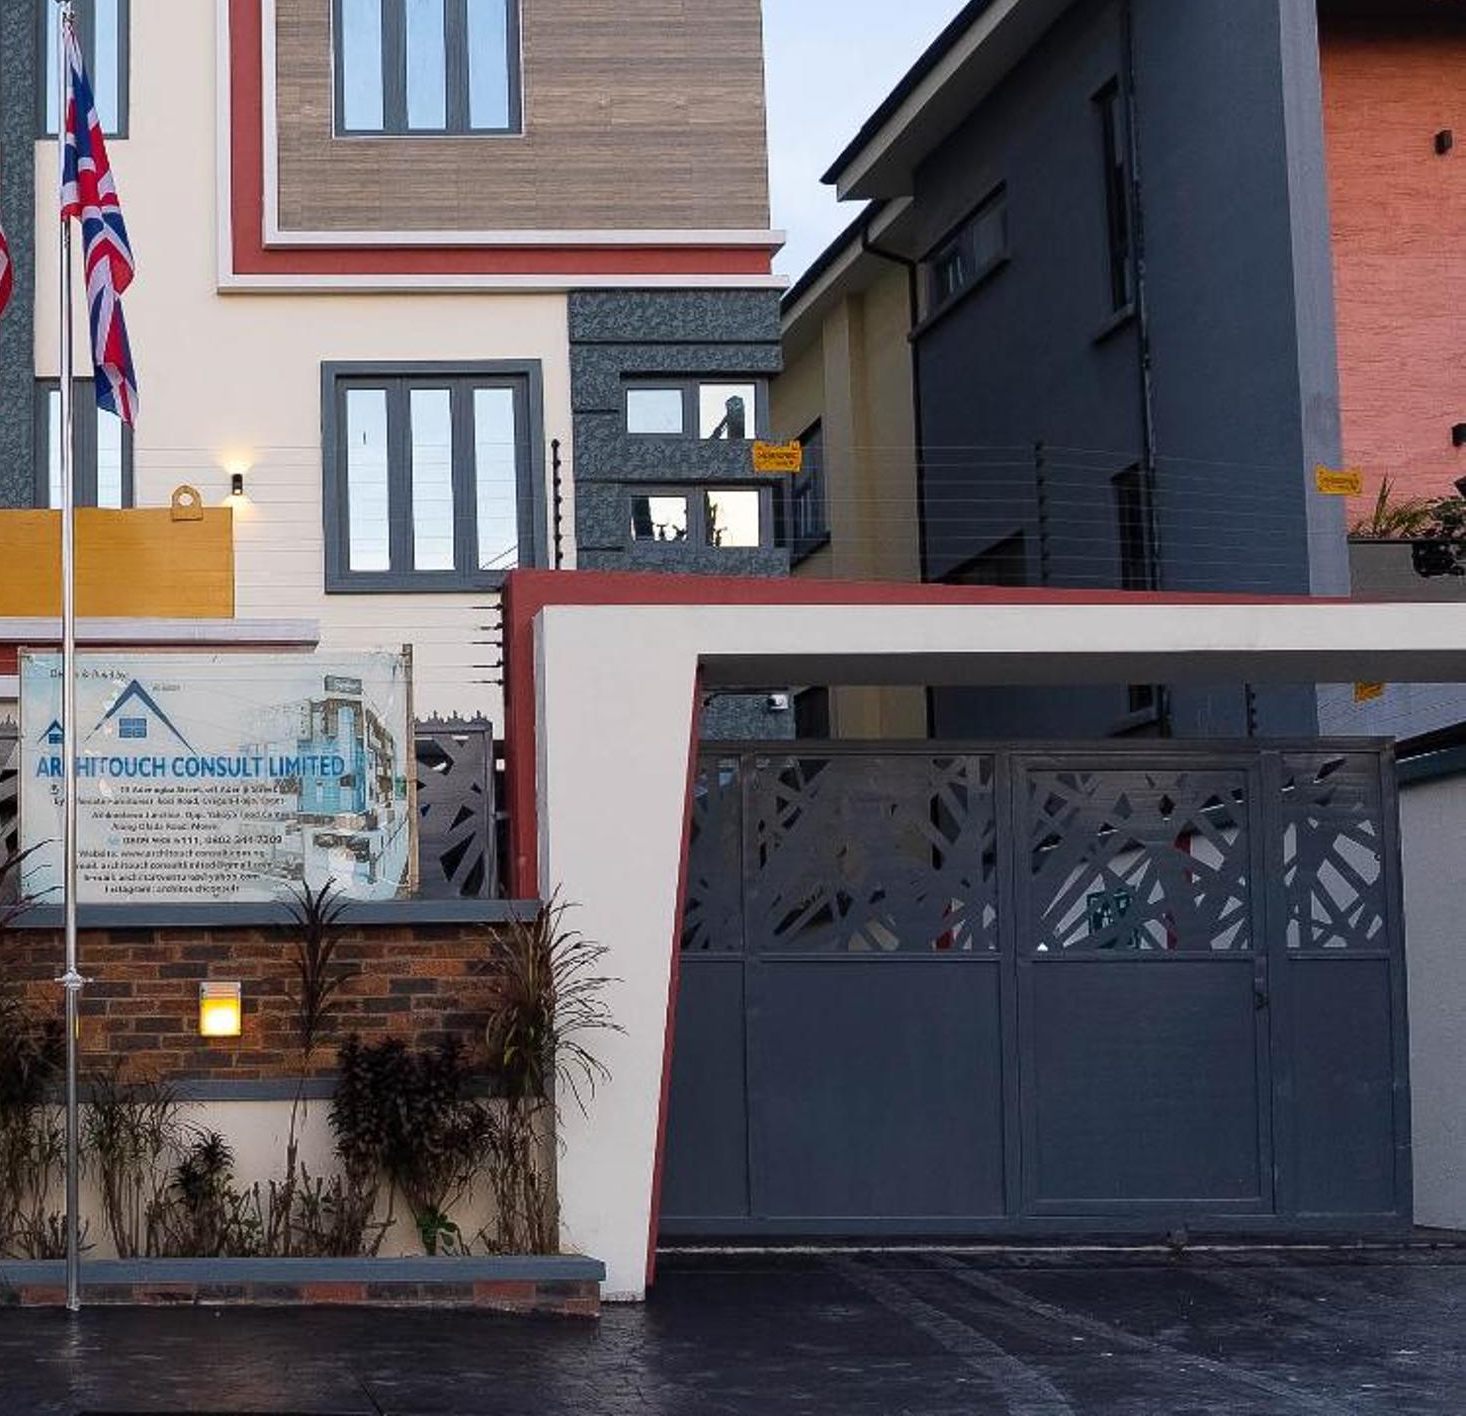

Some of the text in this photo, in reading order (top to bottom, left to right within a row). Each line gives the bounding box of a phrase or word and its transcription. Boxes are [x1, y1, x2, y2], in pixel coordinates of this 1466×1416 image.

[36, 756, 346, 777] ARHITOUCH CONSULT LIMITED
